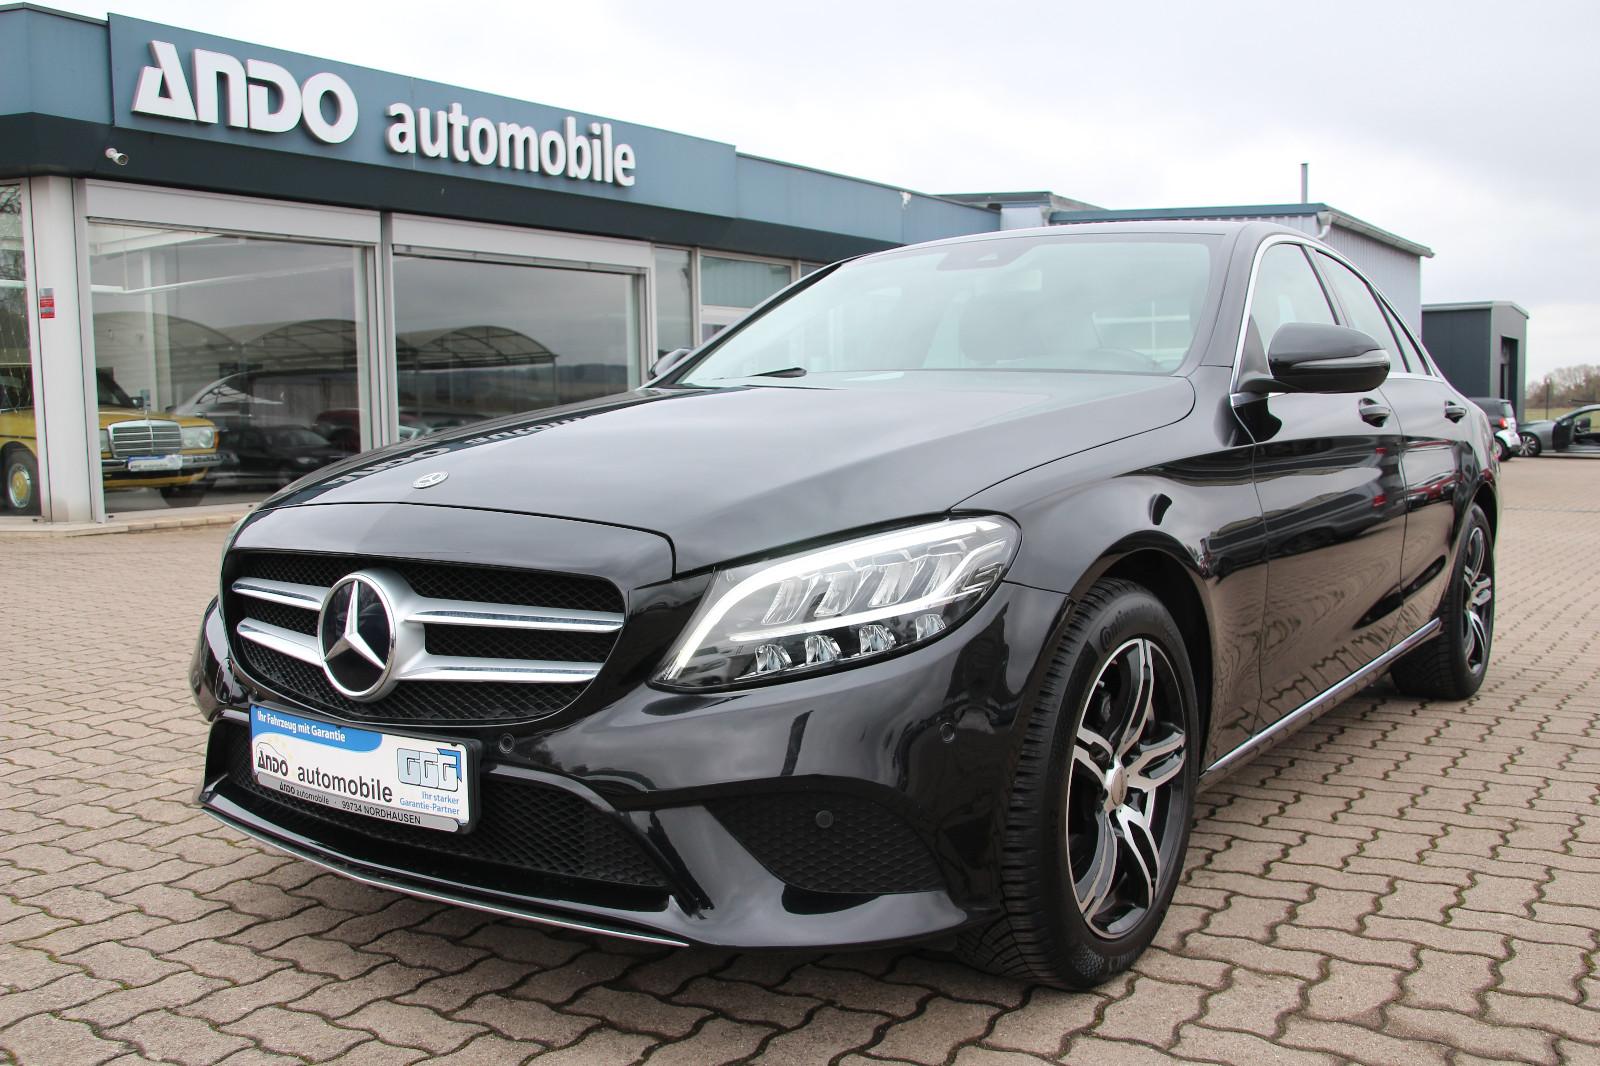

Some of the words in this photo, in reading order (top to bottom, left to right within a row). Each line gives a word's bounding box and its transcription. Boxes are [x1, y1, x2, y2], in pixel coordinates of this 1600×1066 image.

[132, 40, 359, 144] ANDO
[386, 102, 636, 187] automobile
[257, 711, 266, 722] Ihr
[267, 713, 297, 733] Fahrzeug
[298, 723, 311, 735] mit
[311, 725, 346, 742] Garantie
[258, 750, 288, 777] ANDO
[297, 766, 393, 803] automobile
[296, 789, 329, 805] automobile
[341, 800, 362, 813] 99734
[364, 805, 421, 825] NORDHAUSEN
[400, 797, 460, 815] Garantie-Partner
[422, 791, 431, 800] Ihr
[433, 794, 460, 805] starker
